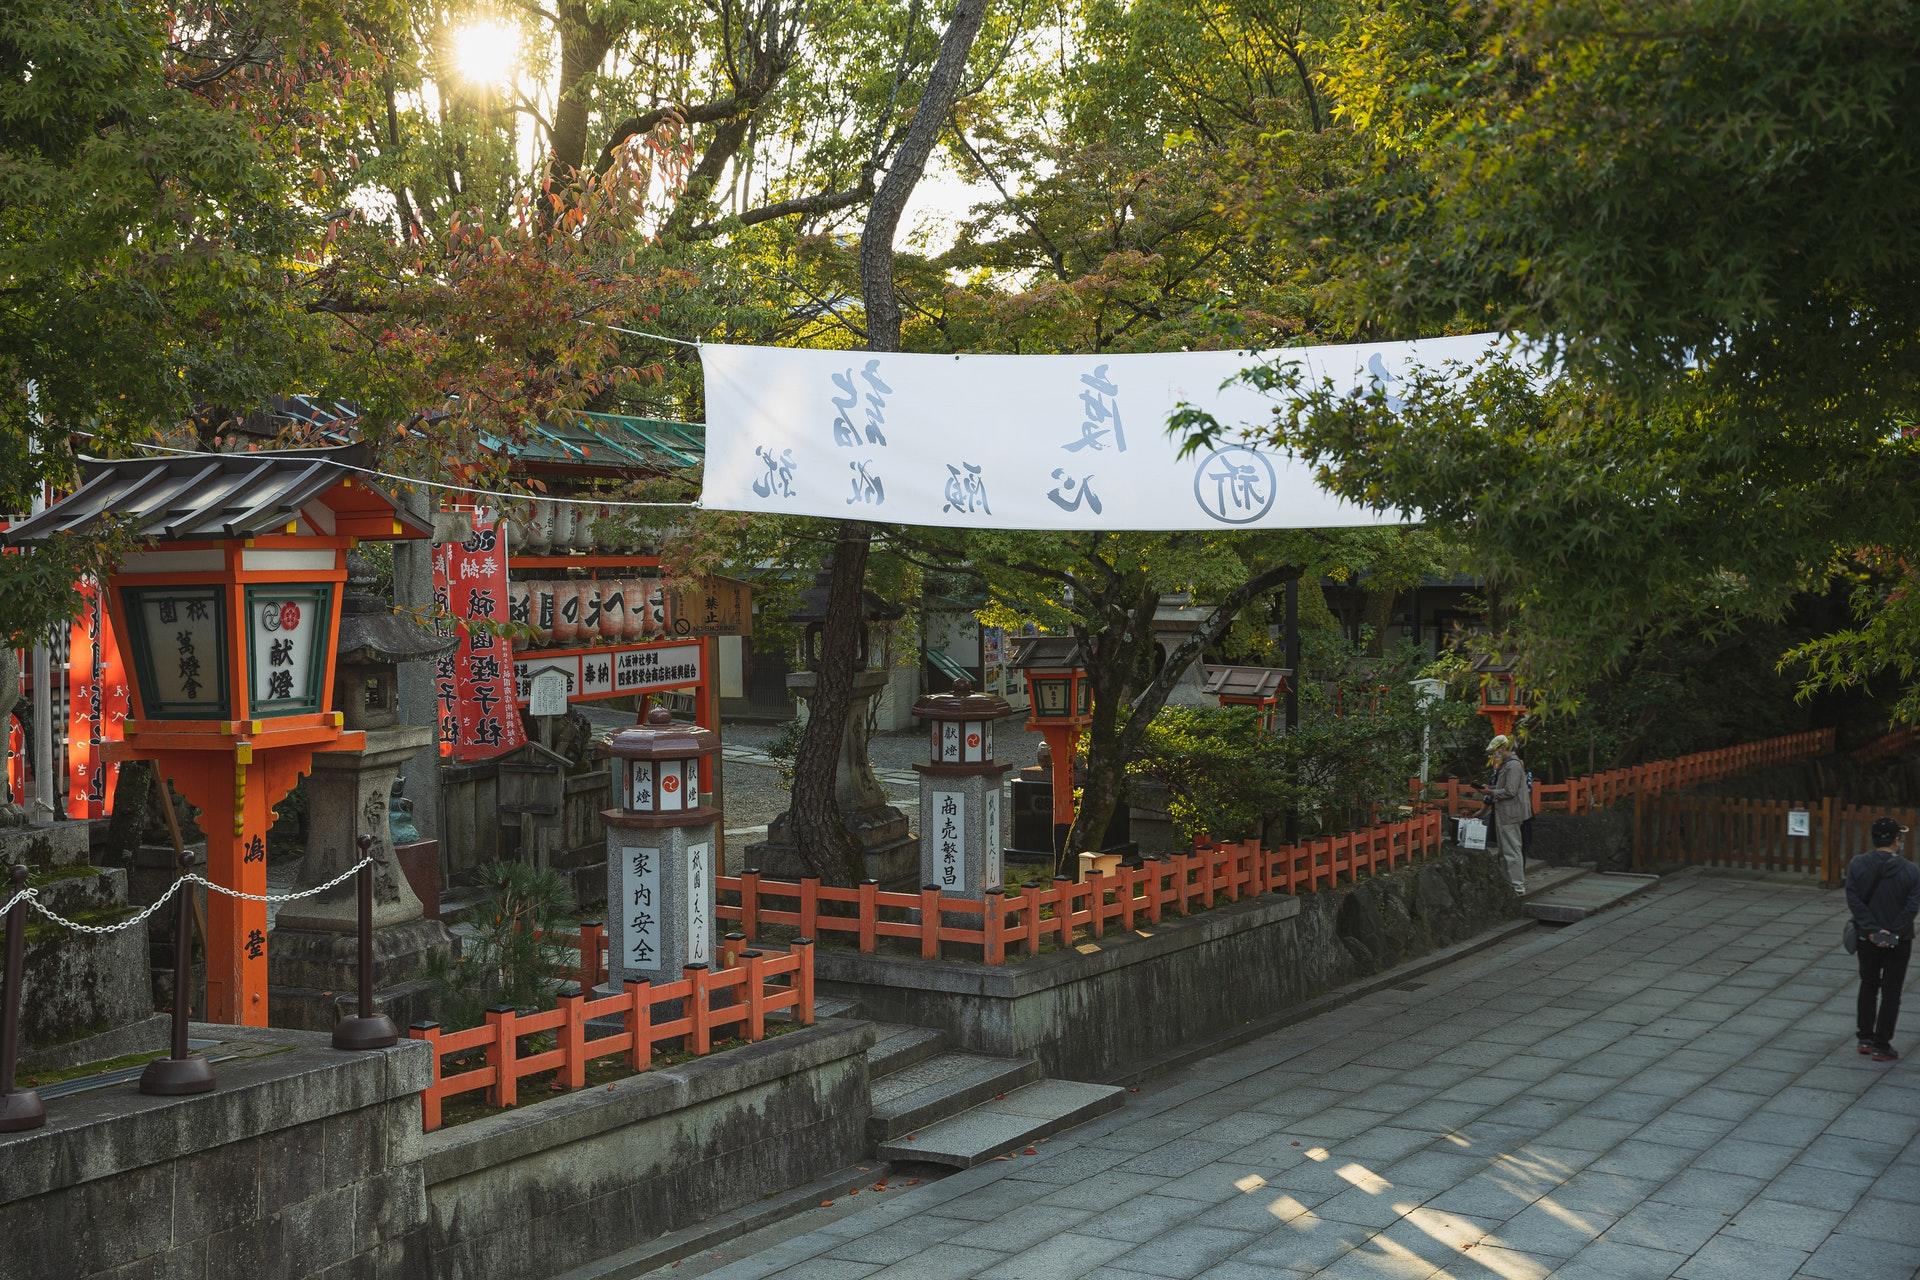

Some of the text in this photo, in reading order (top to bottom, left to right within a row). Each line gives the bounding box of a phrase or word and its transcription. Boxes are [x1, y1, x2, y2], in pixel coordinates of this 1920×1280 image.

[584, 662, 609, 685] 奉納
[941, 794, 958, 885] 商売繁昌
[630, 852, 655, 963] 家内安全
